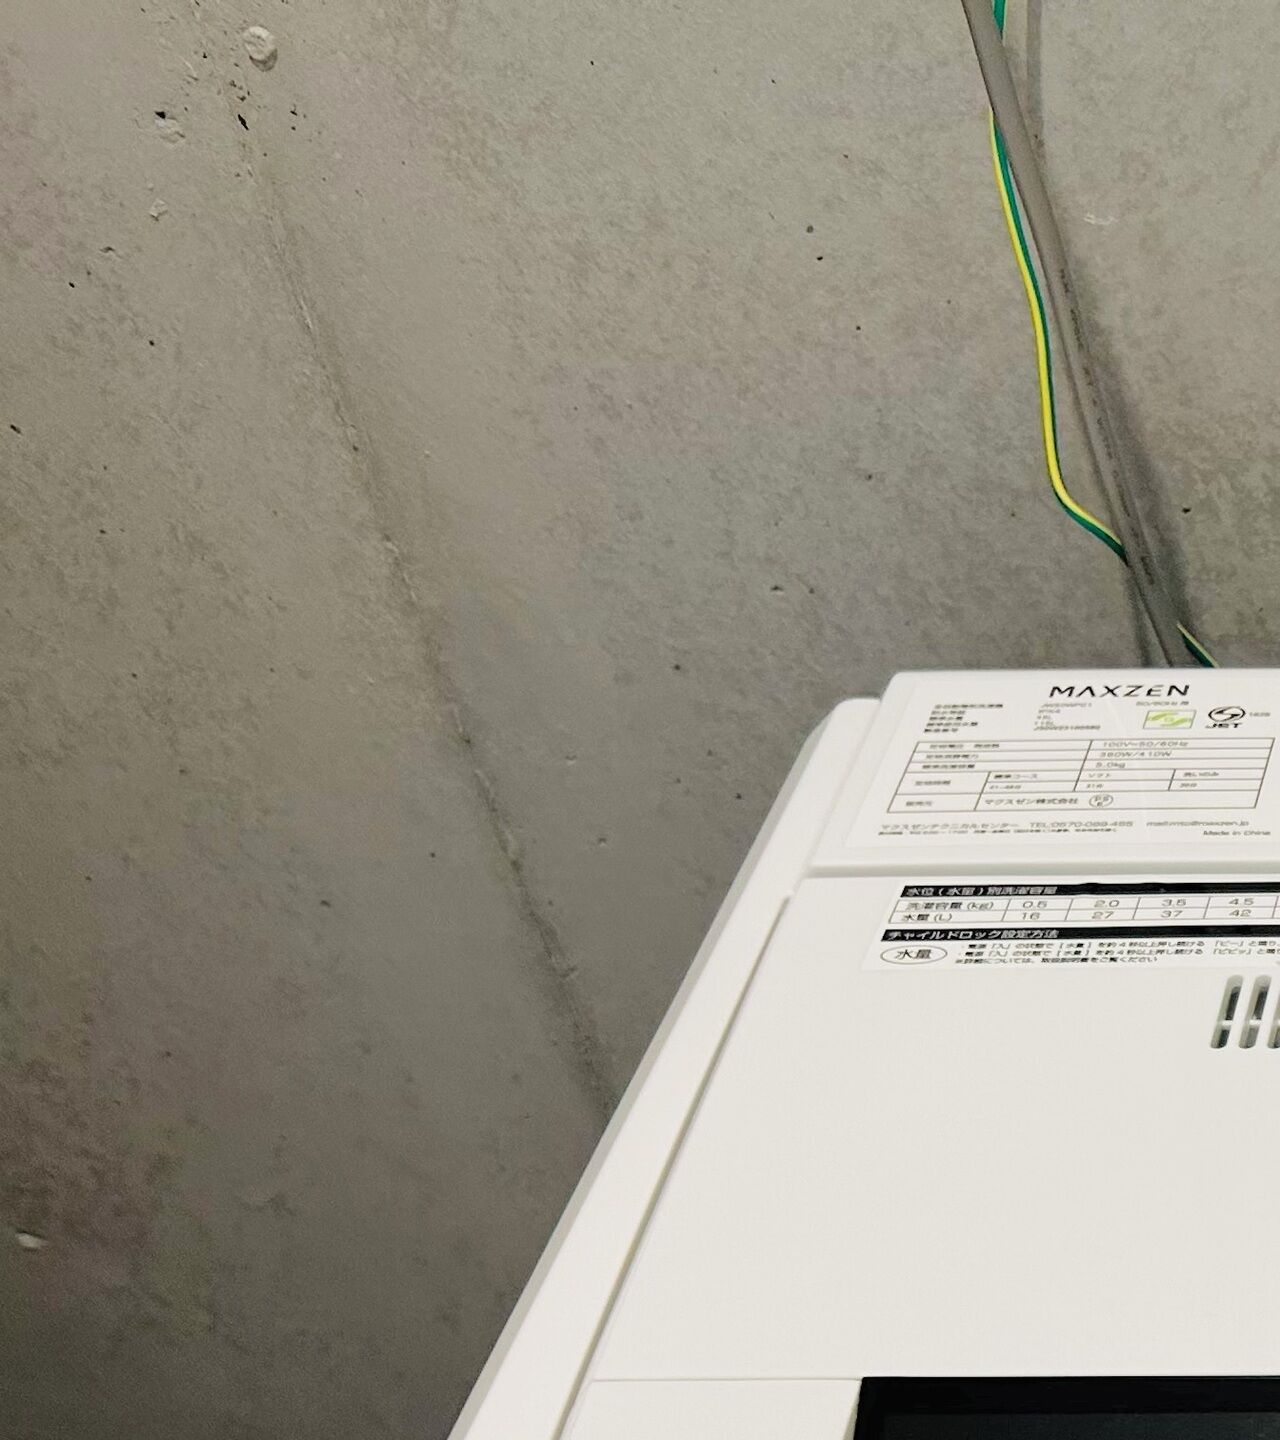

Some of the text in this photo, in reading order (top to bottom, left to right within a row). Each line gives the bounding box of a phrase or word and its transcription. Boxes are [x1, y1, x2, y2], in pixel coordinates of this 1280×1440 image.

[1049, 684, 1191, 698] MAXZEN
[1094, 900, 1119, 908] 2.0
[1160, 899, 1187, 907] 3.5
[1228, 898, 1255, 906] 4.5
[1022, 912, 1041, 920] 16
[1091, 911, 1115, 919] 27
[1160, 910, 1183, 918] 37
[1229, 909, 1252, 917] 42
[887, 930, 1060, 940] チャイルドロック設定方法
[894, 949, 932, 960] 水量
